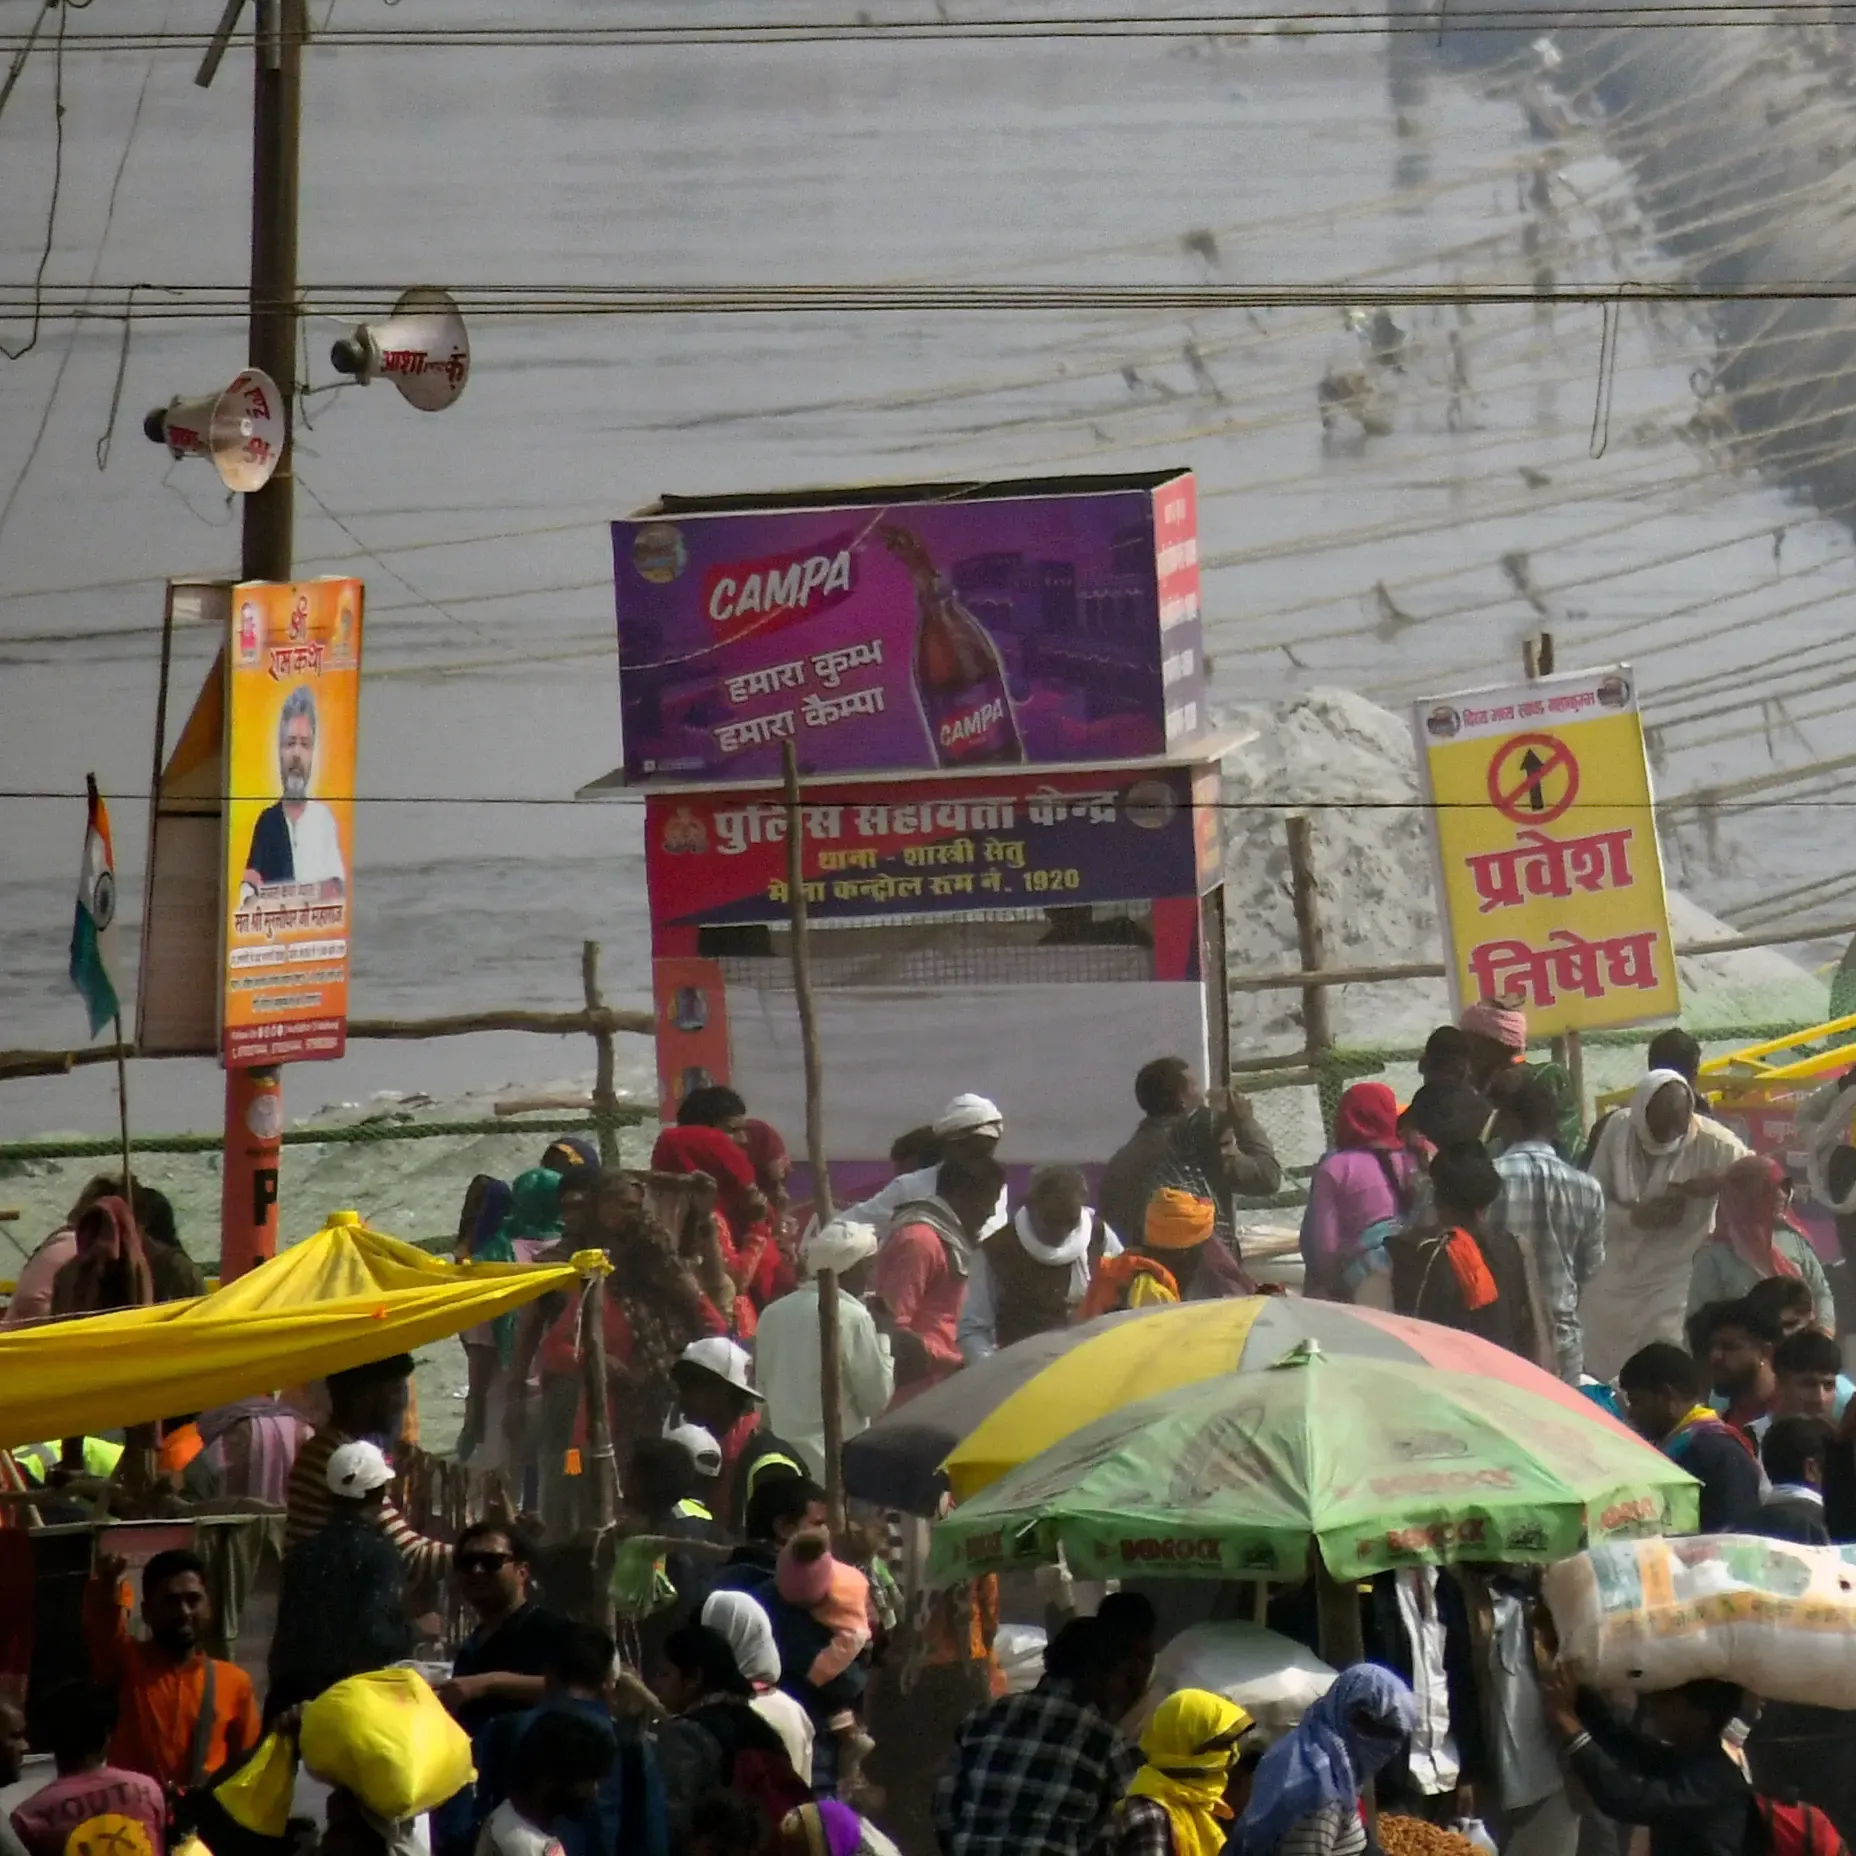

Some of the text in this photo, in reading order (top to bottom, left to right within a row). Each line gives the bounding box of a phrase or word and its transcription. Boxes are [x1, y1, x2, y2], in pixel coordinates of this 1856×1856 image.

[709, 550, 852, 621] CAMPA
[724, 639, 884, 704] हमारा कुम्भ
[713, 685, 886, 752] हमारा कैम्पा
[939, 698, 1004, 747] CAMPA
[713, 796, 841, 856] पुलिस
[853, 793, 1016, 836] सहायता
[818, 847, 877, 871] थाना
[903, 836, 974, 868] शास्त्री
[984, 837, 1026, 869] सेतु
[1023, 869, 1081, 892] 1920
[1465, 828, 1634, 914] प्रवेश
[1467, 930, 1659, 1011] निषेध
